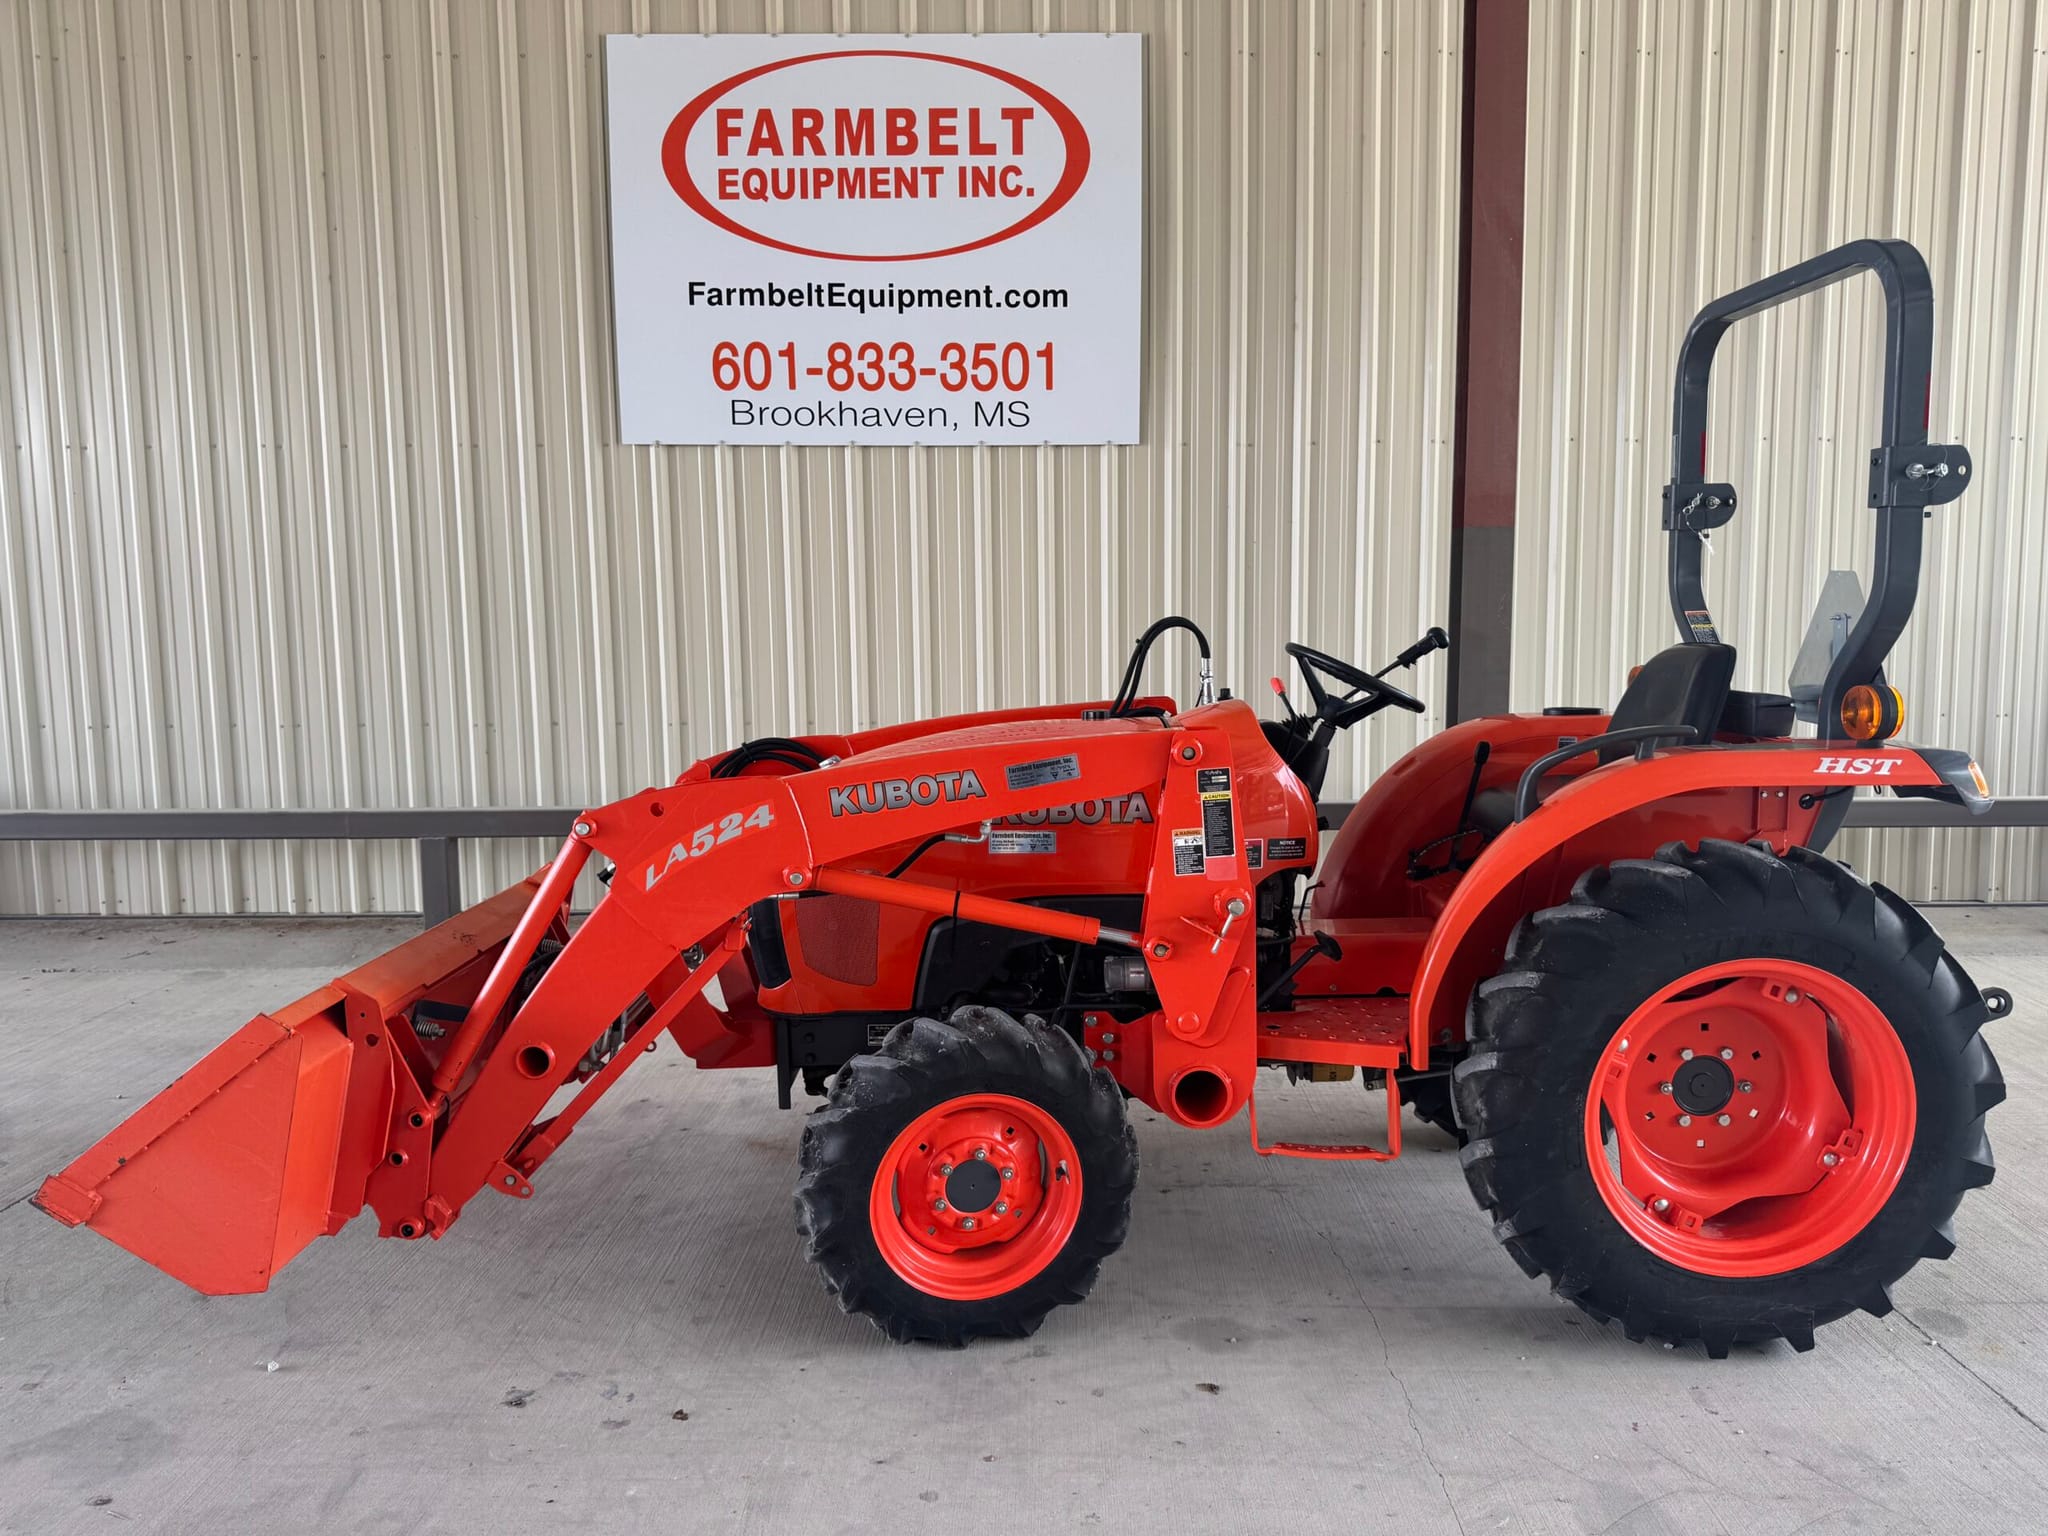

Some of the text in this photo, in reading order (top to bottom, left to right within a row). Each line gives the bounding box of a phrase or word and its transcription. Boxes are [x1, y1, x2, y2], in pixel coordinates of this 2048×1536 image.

[716, 107, 1035, 157] FARMBELT
[717, 164, 1036, 203] EQUIPMENT INC.
[688, 281, 1069, 315] FarmbeltEquipment.com
[712, 340, 1055, 392] 601-833-3501
[731, 399, 1031, 431] Brookhaven, MS
[1813, 756, 1902, 776] HST
[829, 769, 987, 818] KUBOTA
[645, 804, 775, 892] LA524
